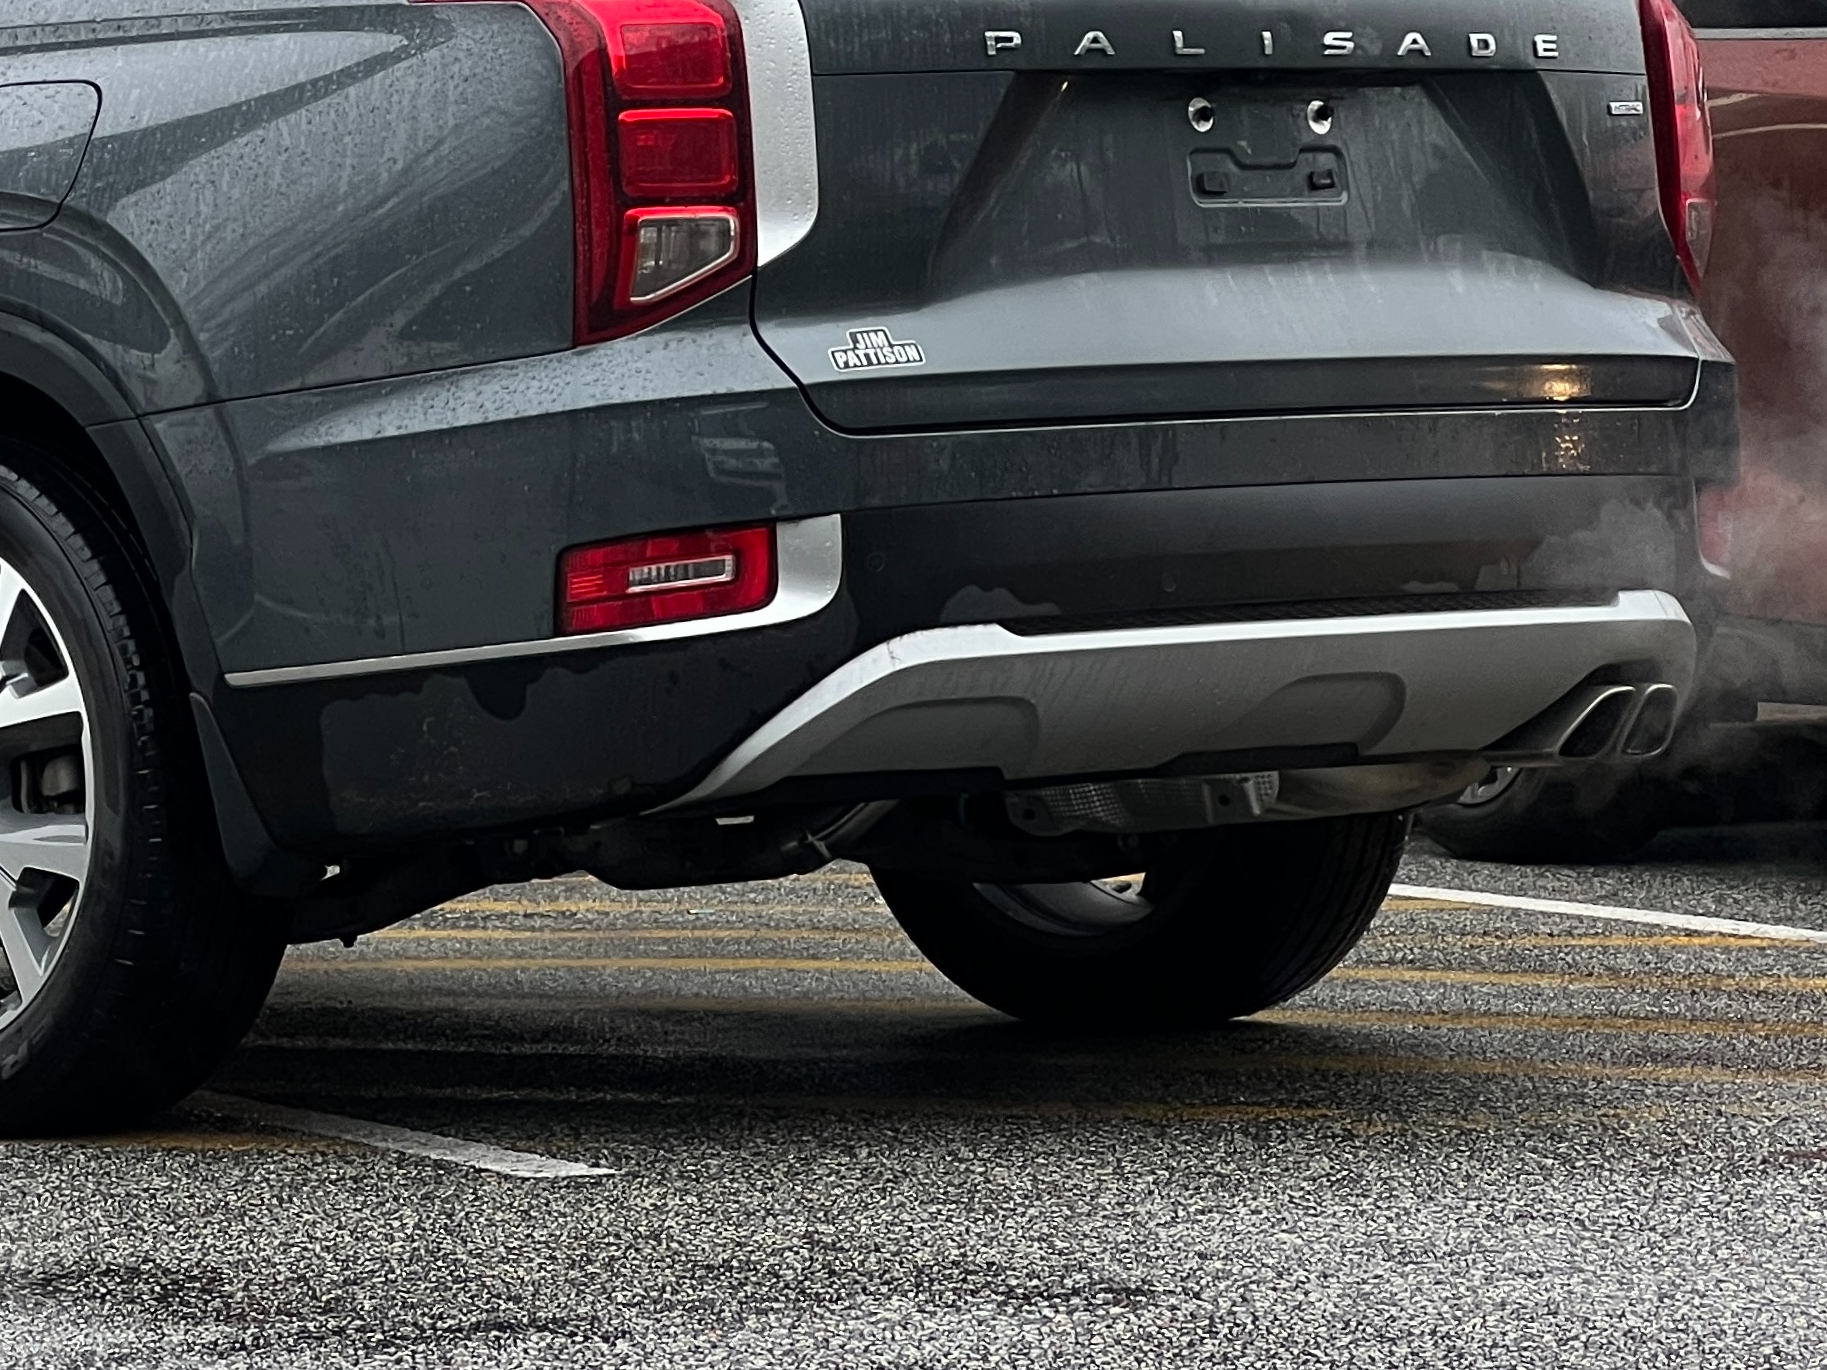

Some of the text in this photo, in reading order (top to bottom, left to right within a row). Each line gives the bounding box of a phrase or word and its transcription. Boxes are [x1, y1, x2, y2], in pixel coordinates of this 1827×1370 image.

[983, 29, 1560, 59] PALISADE
[855, 331, 889, 350] JIM
[833, 344, 921, 369] PATTISON
